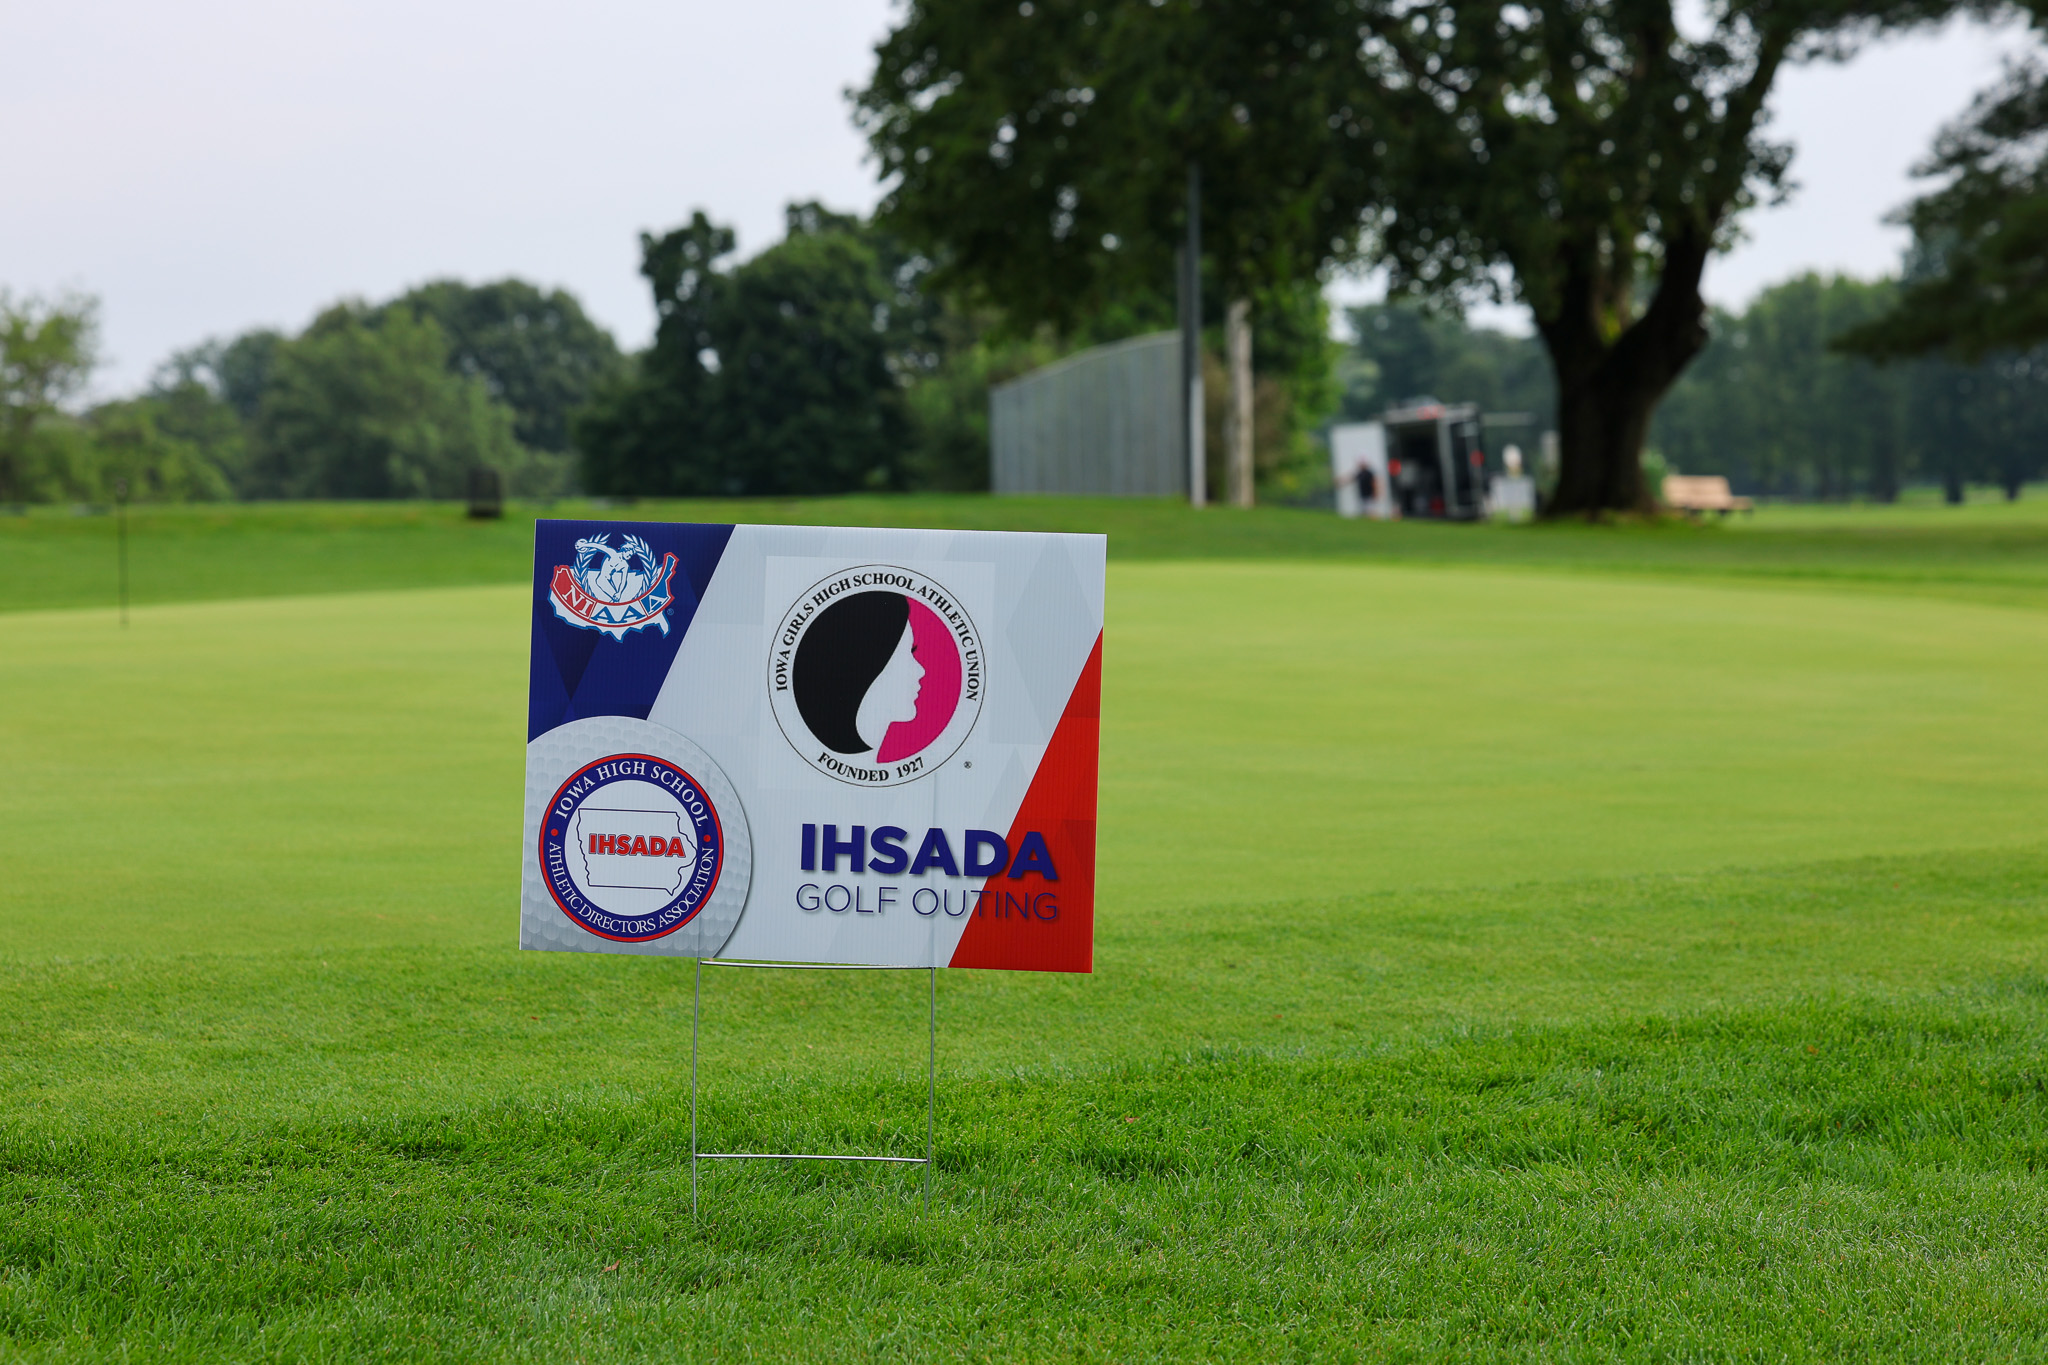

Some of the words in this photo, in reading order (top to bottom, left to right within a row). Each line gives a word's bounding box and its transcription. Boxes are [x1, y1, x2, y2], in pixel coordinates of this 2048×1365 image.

[562, 584, 668, 623] NIAAA
[812, 577, 852, 607] HIGH
[852, 573, 916, 592] SCHOOL
[782, 602, 814, 647] GIRLS
[914, 585, 974, 648] ATHLETIC
[775, 649, 791, 692] IOWA
[965, 649, 980, 702] UNION
[817, 751, 889, 782] FOUNDED
[896, 756, 925, 779] 1927
[555, 776, 596, 820] IOWA
[595, 761, 647, 781] HIGH
[650, 765, 708, 827] SCHOOL
[588, 833, 686, 858] IHSADA
[800, 822, 1059, 881] IHSADA
[549, 842, 583, 910] ATHLETIC
[577, 905, 657, 934] DIRECTORS
[658, 847, 715, 929] ASSOCIATION
[796, 883, 898, 914] GOLF
[912, 887, 1058, 920] OUTING
